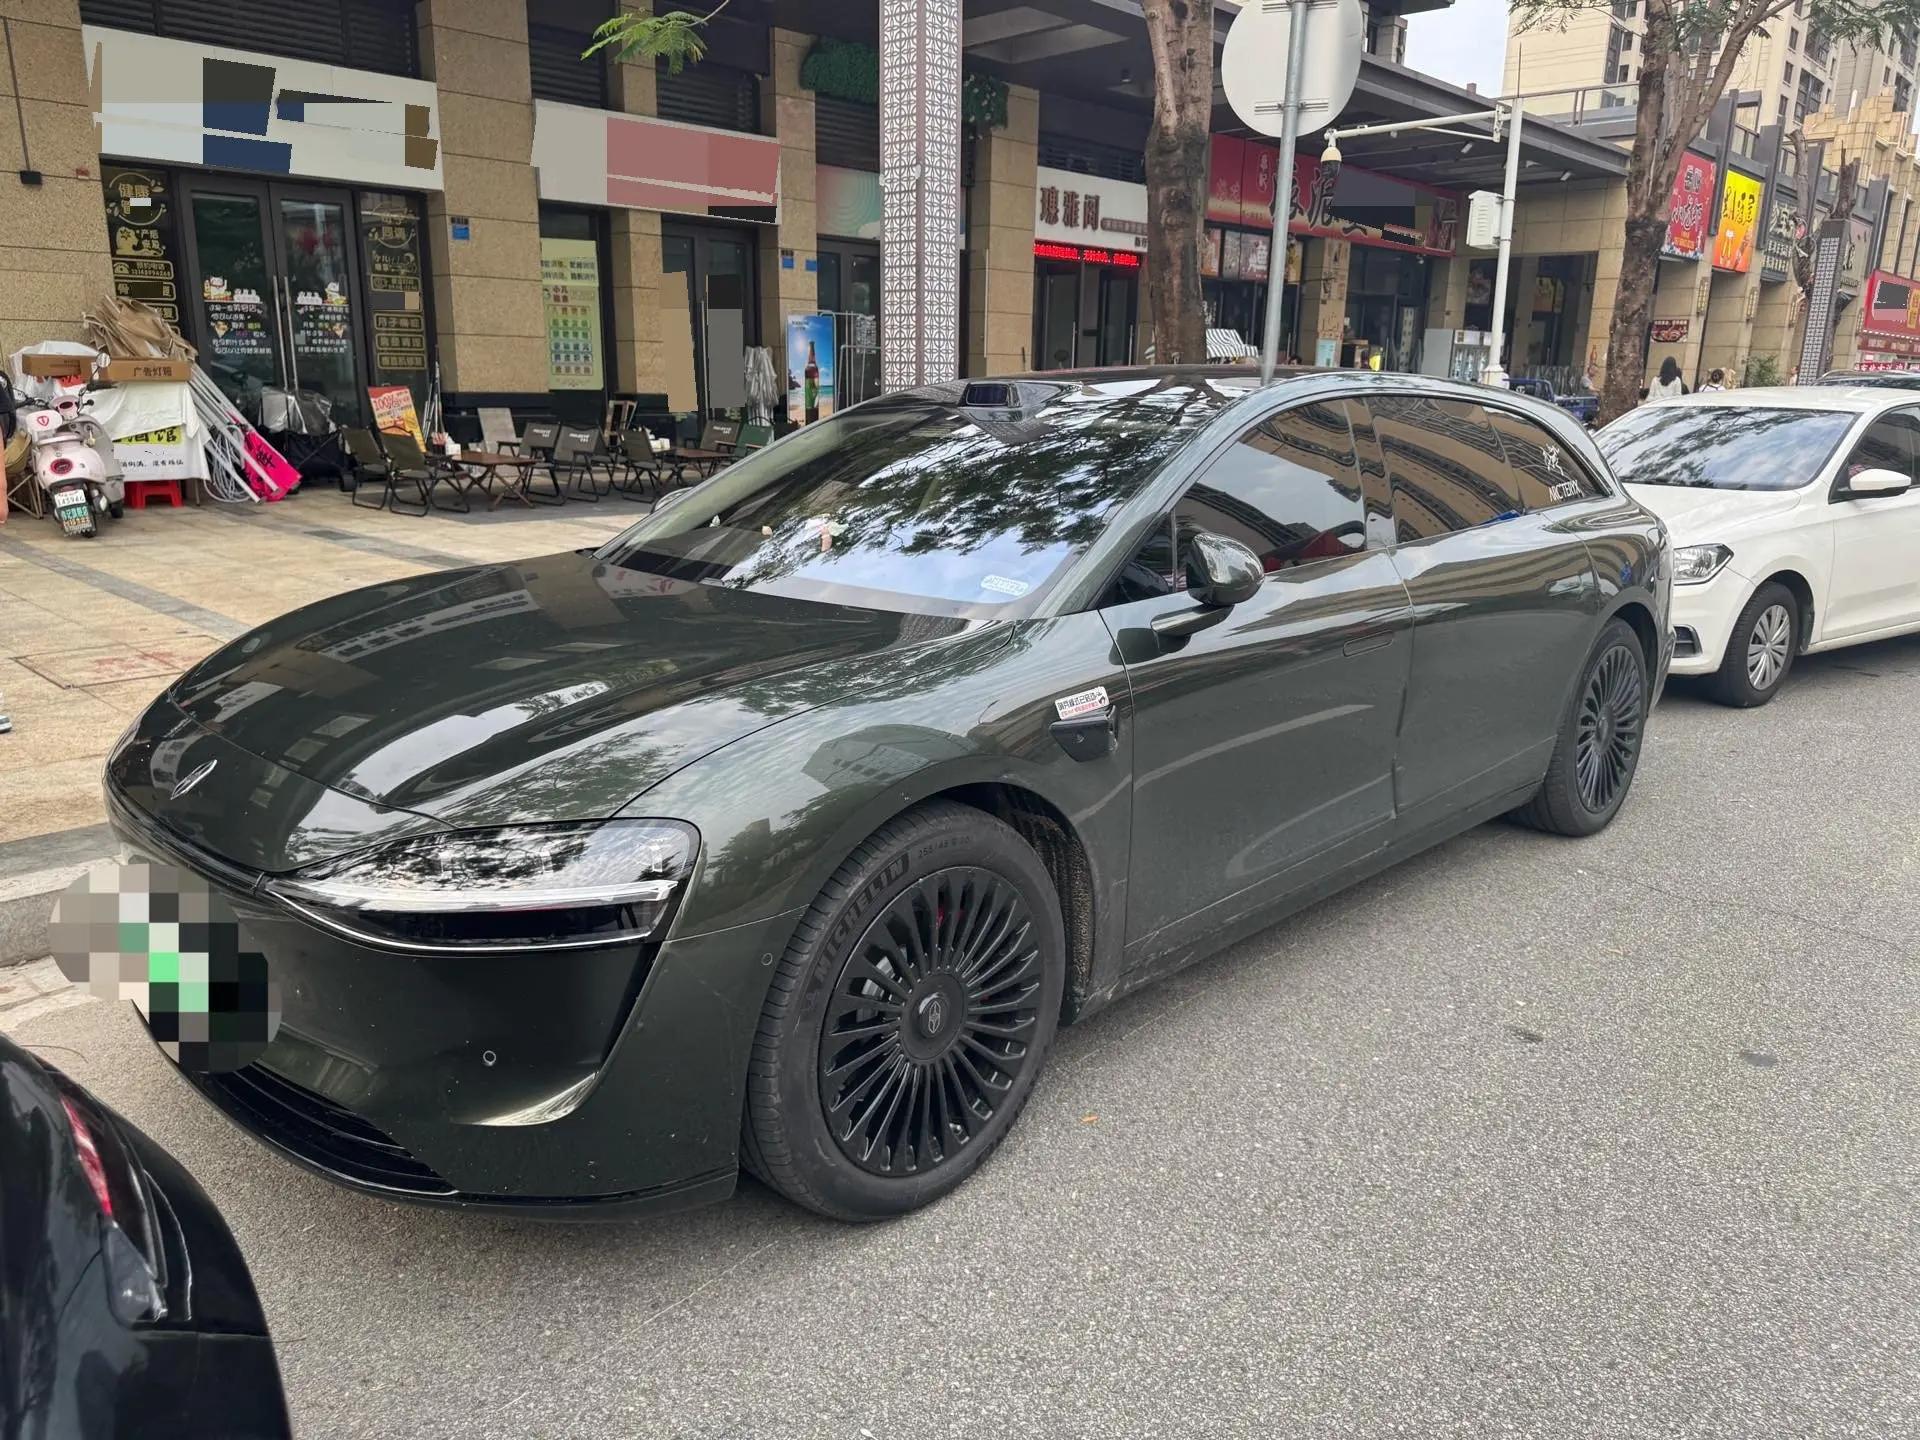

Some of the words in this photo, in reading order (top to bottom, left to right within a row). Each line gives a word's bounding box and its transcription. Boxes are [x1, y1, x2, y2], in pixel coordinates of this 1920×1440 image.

[118, 183, 151, 198] 健康
[133, 367, 172, 378] 广告灯箱
[813, 861, 904, 983] MICHELIN
